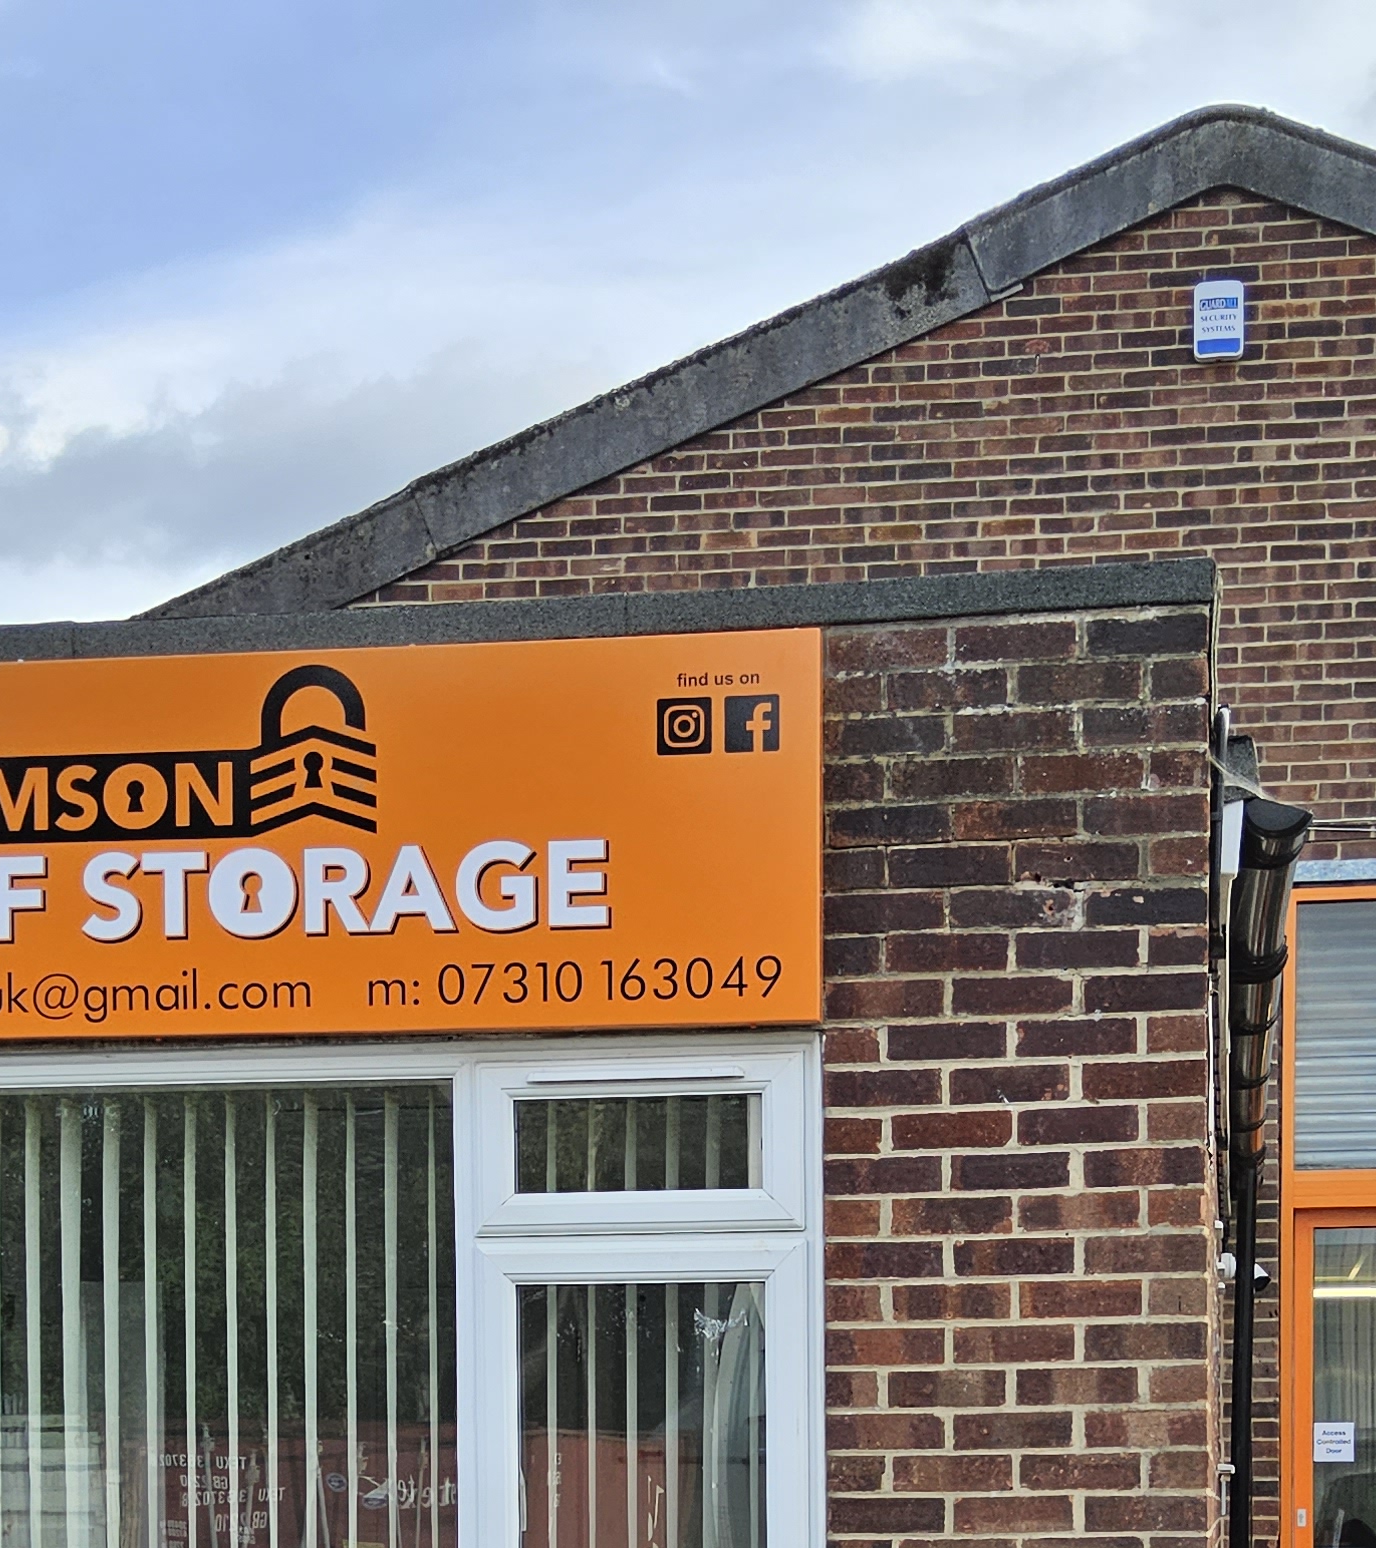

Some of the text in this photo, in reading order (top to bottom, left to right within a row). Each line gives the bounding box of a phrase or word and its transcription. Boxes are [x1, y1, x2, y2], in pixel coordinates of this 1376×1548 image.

[677, 672, 759, 687] find us on
[81, 837, 612, 944] STORAGE
[367, 978, 420, 1006] m:
[437, 961, 583, 1005] 07310
[600, 955, 782, 1002] 163049
